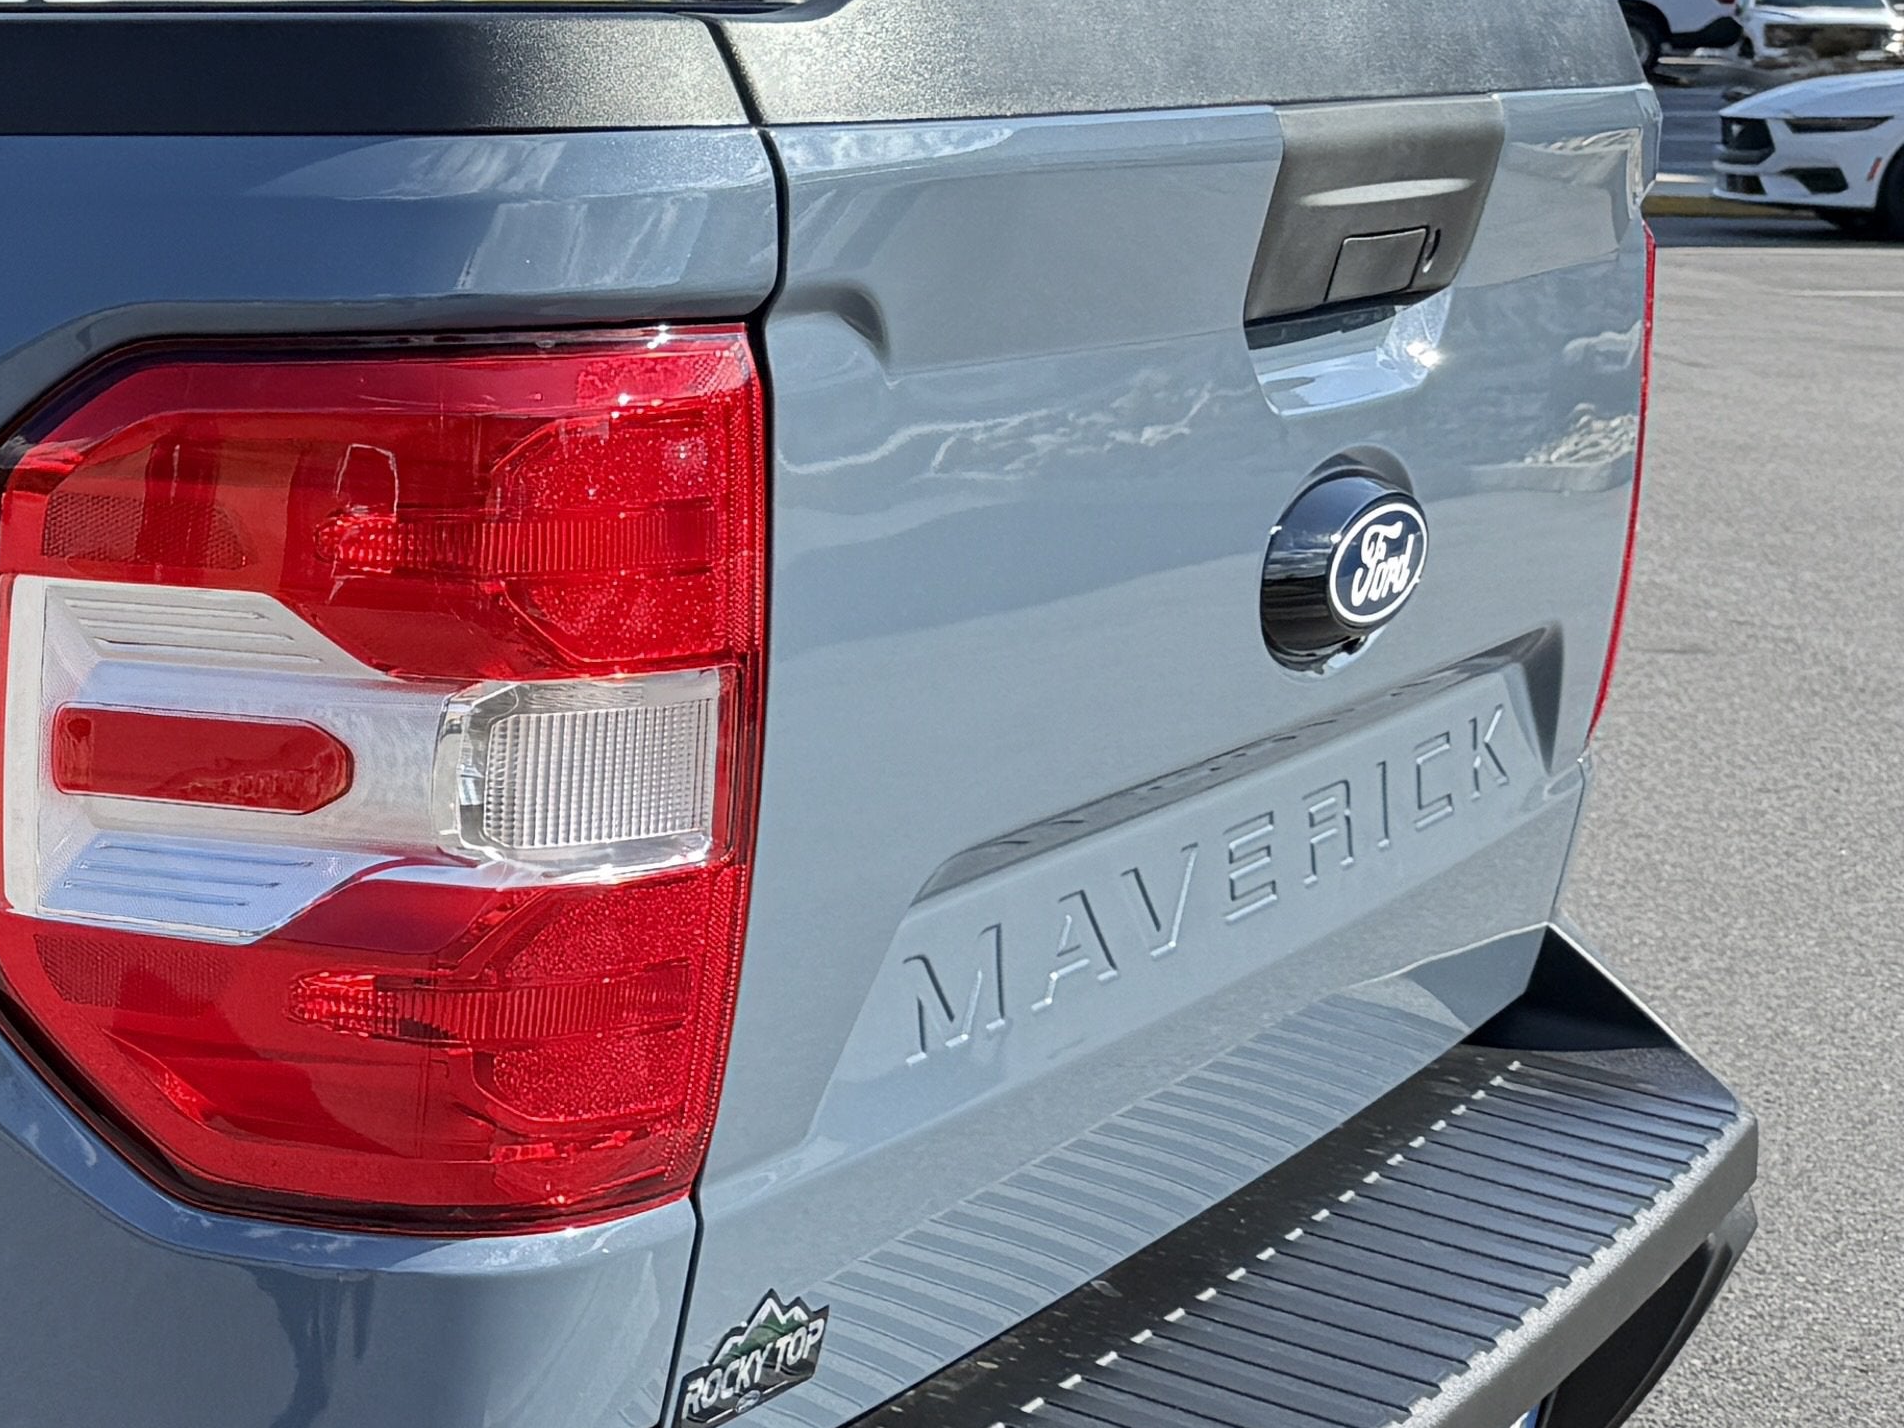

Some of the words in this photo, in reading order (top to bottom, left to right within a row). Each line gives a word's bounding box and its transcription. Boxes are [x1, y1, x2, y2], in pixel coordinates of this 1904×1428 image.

[1351, 521, 1415, 607] Ford
[903, 703, 1510, 1067] MAVERICK
[681, 1343, 774, 1419] ROCKY
[775, 1318, 825, 1372] TOP
